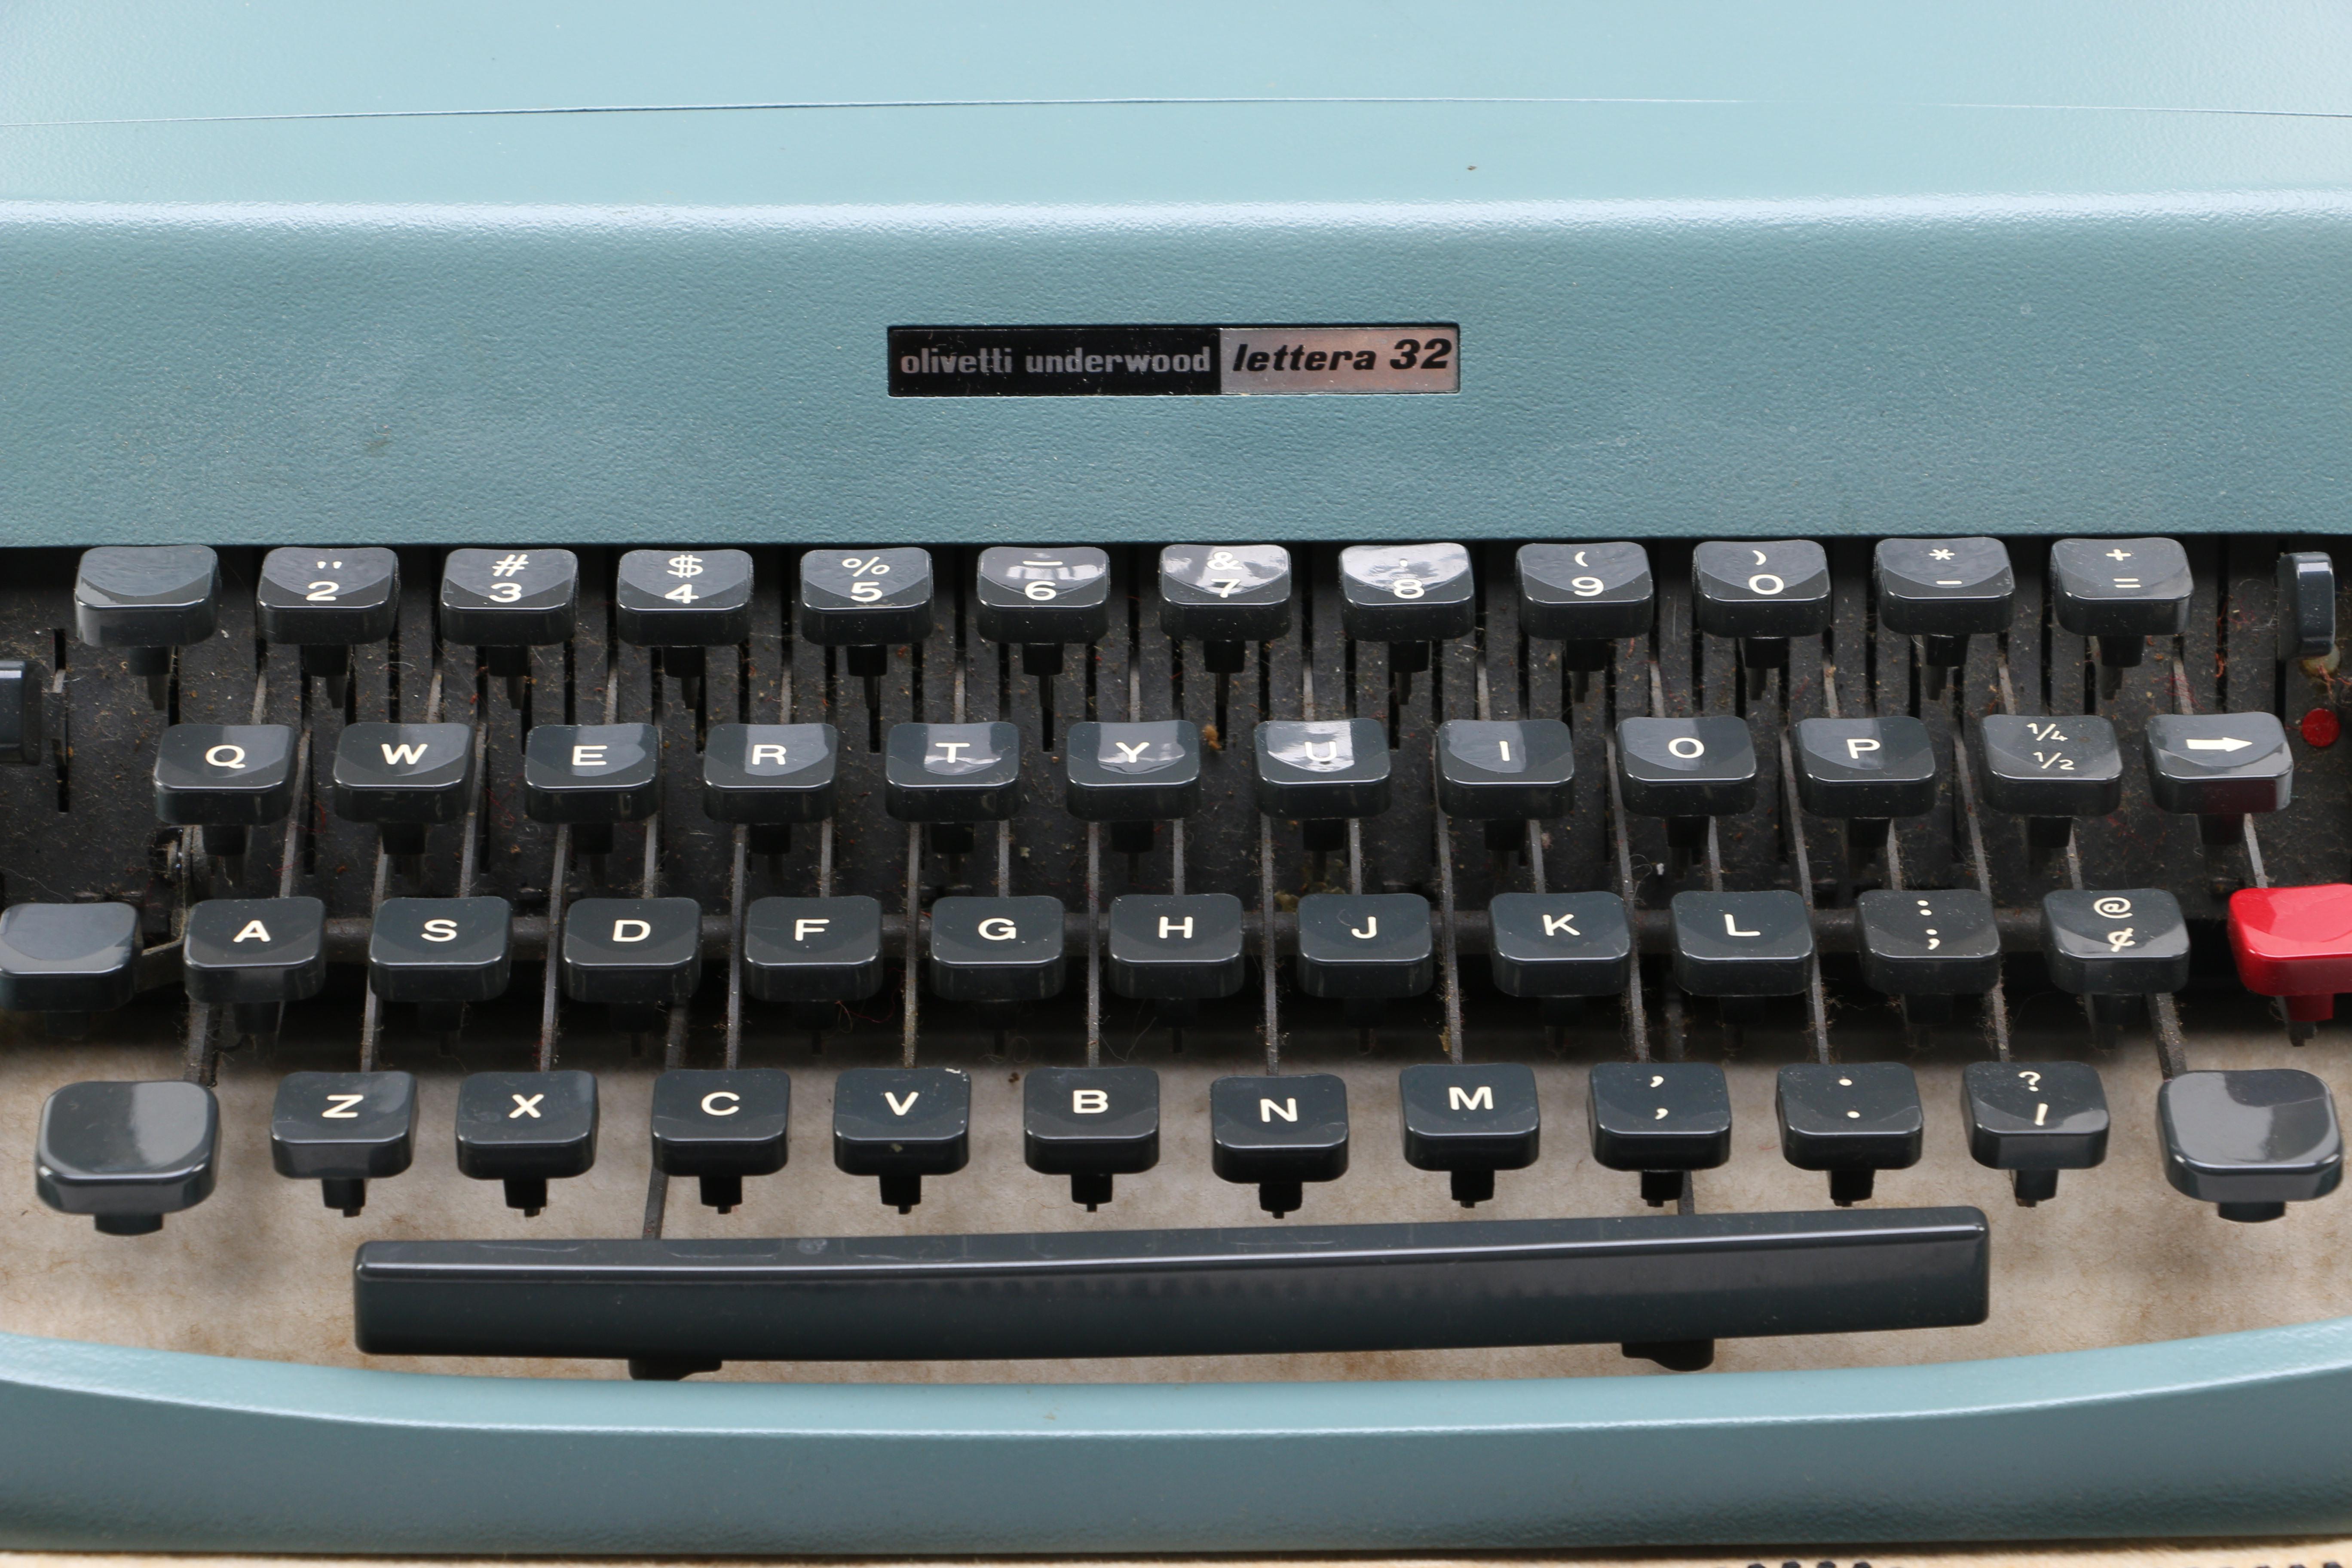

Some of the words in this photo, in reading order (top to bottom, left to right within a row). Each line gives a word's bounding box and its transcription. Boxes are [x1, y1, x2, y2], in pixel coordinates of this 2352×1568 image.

[901, 348, 1012, 373] olivetti
[1026, 346, 1210, 372] underwood
[1233, 343, 1377, 371] lettera
[1390, 338, 1452, 370] 32
[492, 554, 528, 576] #
[1207, 551, 1244, 570] &
[1574, 551, 1588, 566] (
[1754, 550, 1767, 564] )
[2105, 548, 2132, 560] +
[667, 554, 704, 577] $
[842, 557, 890, 576] %
[306, 581, 339, 601] 2
[488, 582, 521, 601] 3
[664, 582, 698, 604] 4
[850, 581, 883, 601] 5
[1025, 581, 1057, 600] 6
[1211, 578, 1241, 598] 7
[1393, 578, 1425, 599] 8
[1571, 576, 1605, 595] 9
[2113, 578, 2142, 588] =
[205, 745, 246, 769] Q
[381, 743, 428, 765] W
[572, 745, 608, 766] E
[751, 744, 787, 765] R
[935, 742, 971, 763] T
[1115, 741, 1151, 763] Y
[1304, 741, 1336, 762] U
[1499, 741, 1510, 760] I
[1668, 737, 1705, 758] O
[1847, 738, 1880, 758] P
[1917, 900, 1932, 915] :
[2093, 897, 2133, 919] @
[233, 920, 270, 943] A
[421, 919, 457, 942] S
[613, 920, 651, 942] D
[795, 919, 830, 941] F
[978, 918, 1017, 940] G
[1159, 916, 1193, 939] H
[1351, 916, 1378, 939] J
[1543, 914, 1580, 936] K
[1724, 914, 1761, 936] L
[1926, 929, 1940, 949] ;
[2018, 1072, 2041, 1092] ?
[322, 1094, 364, 1118] Z
[509, 1094, 544, 1118] X
[701, 1092, 740, 1116] C
[885, 1092, 919, 1116] V
[1073, 1090, 1109, 1114] B
[1449, 1087, 1493, 1110] M
[1260, 1098, 1298, 1122] N
